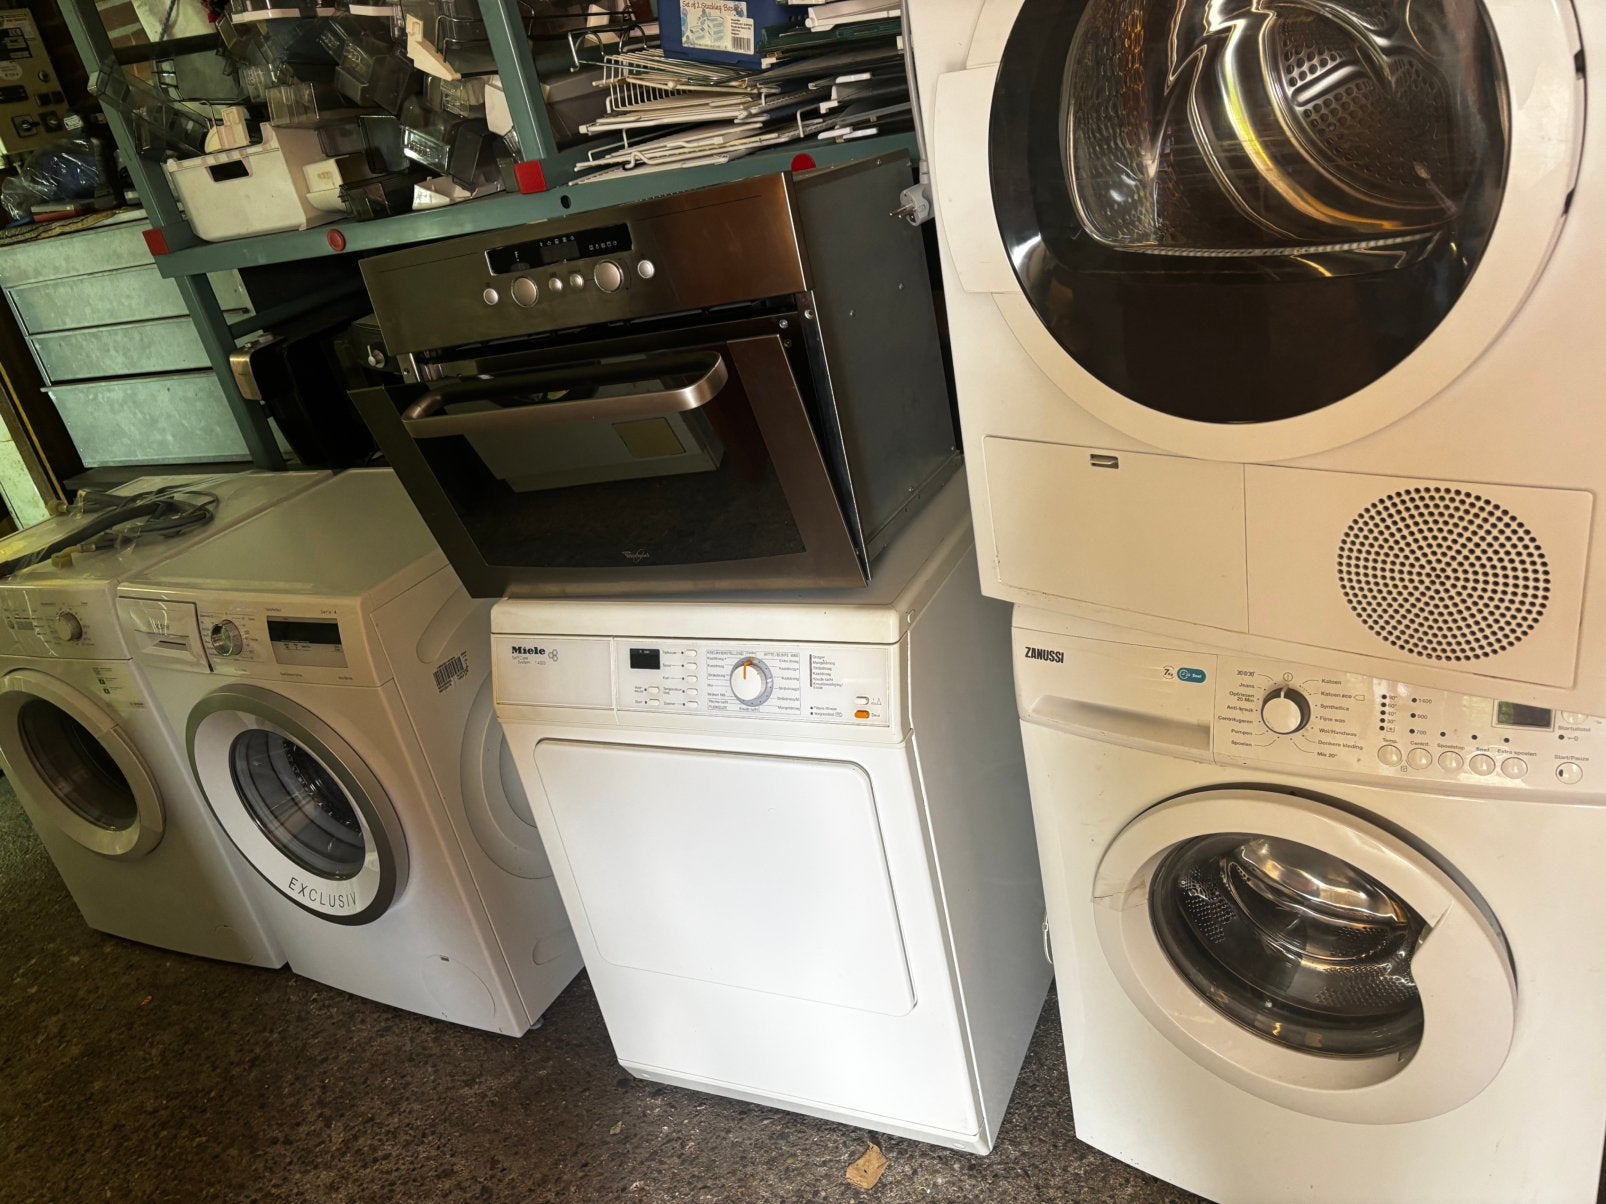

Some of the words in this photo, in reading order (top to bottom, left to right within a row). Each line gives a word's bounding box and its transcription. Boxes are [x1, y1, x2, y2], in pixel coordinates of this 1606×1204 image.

[512, 646, 546, 655] Miele
[1025, 646, 1064, 664] ZANUSSI
[1318, 740, 1341, 748] Donkere
[1342, 742, 1363, 751] kleding
[288, 877, 356, 908] EXCLUSIV
